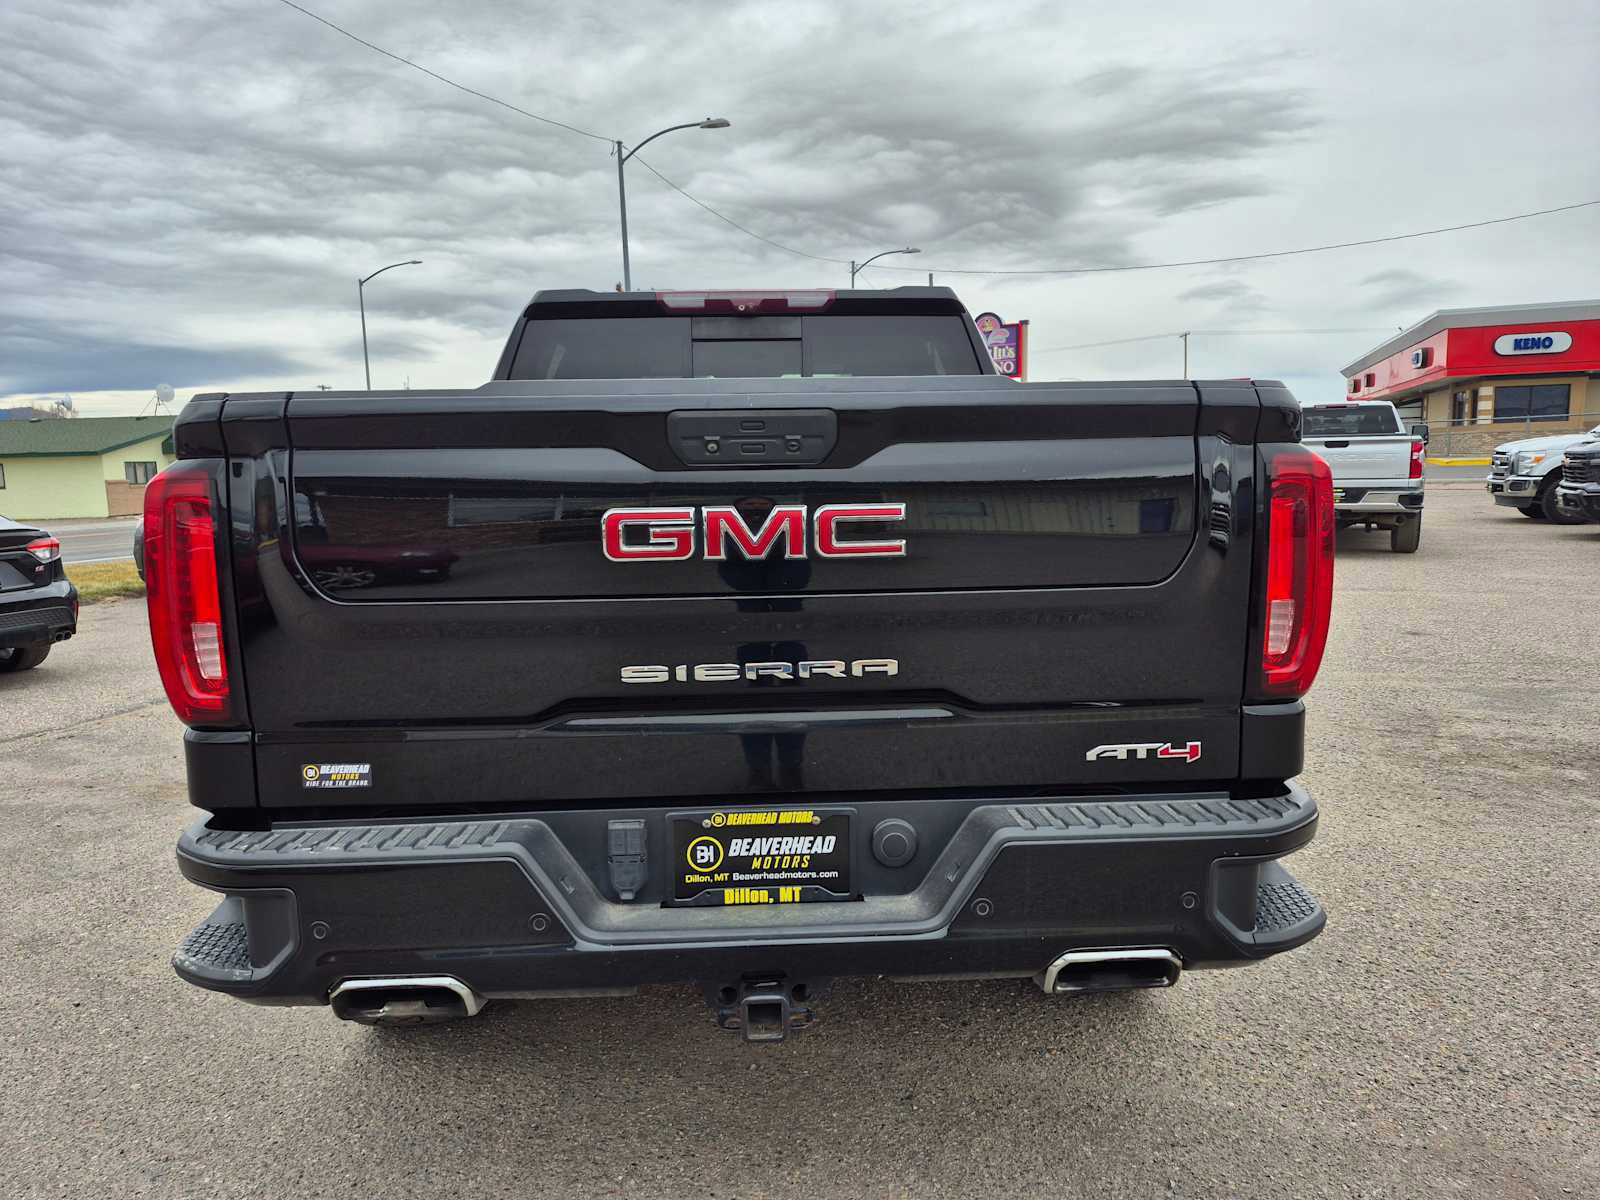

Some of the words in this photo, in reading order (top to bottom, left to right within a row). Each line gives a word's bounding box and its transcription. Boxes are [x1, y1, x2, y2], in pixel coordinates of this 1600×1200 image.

[1513, 336, 1554, 351] KENO
[601, 503, 906, 562] GMC
[620, 659, 898, 683] SIERRA
[1086, 741, 1201, 763] AT4
[320, 764, 370, 774] BEAVERHEAD
[726, 812, 779, 826] BEAVERHEAD
[778, 811, 814, 824] MOTORS
[728, 836, 837, 857] BEAVERHEAD
[752, 855, 811, 870] MOTORS
[685, 873, 713, 884] Dillon,
[714, 872, 730, 882] MT
[732, 870, 838, 882] Beaverheadmotors.com
[723, 887, 774, 905] Dillon,
[779, 886, 801, 903] MT
